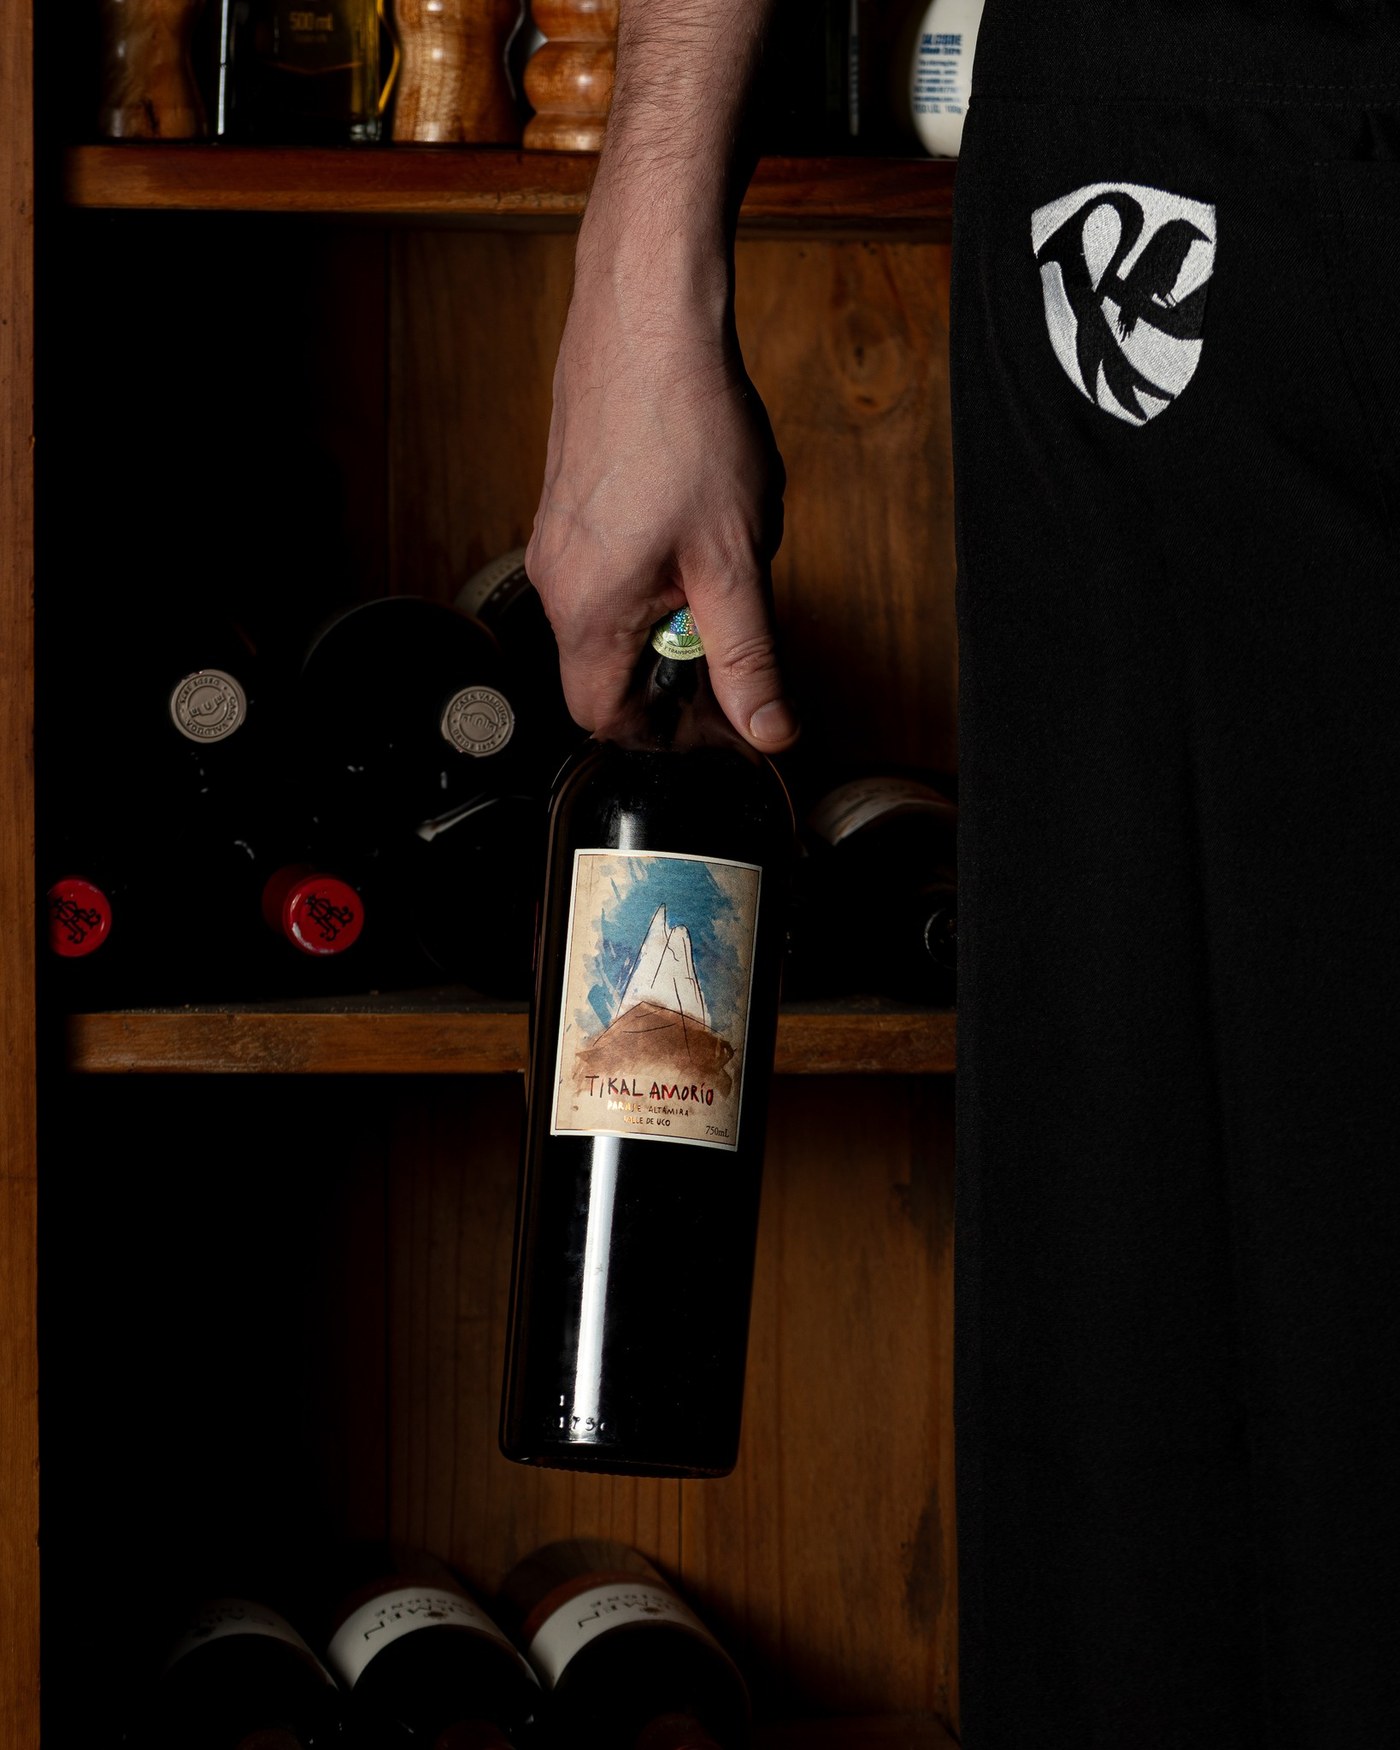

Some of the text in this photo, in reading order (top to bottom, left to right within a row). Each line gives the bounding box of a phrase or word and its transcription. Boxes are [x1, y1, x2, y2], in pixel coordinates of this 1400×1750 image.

[454, 692, 508, 727] CASA VALDUGA
[186, 719, 229, 736] VALDUGA
[585, 1074, 644, 1098] TIKAL
[607, 1101, 689, 1117] PARAJE ALTAMIRA
[623, 1115, 671, 1127] VALLE DE UCO
[705, 1125, 731, 1138] 750mL
